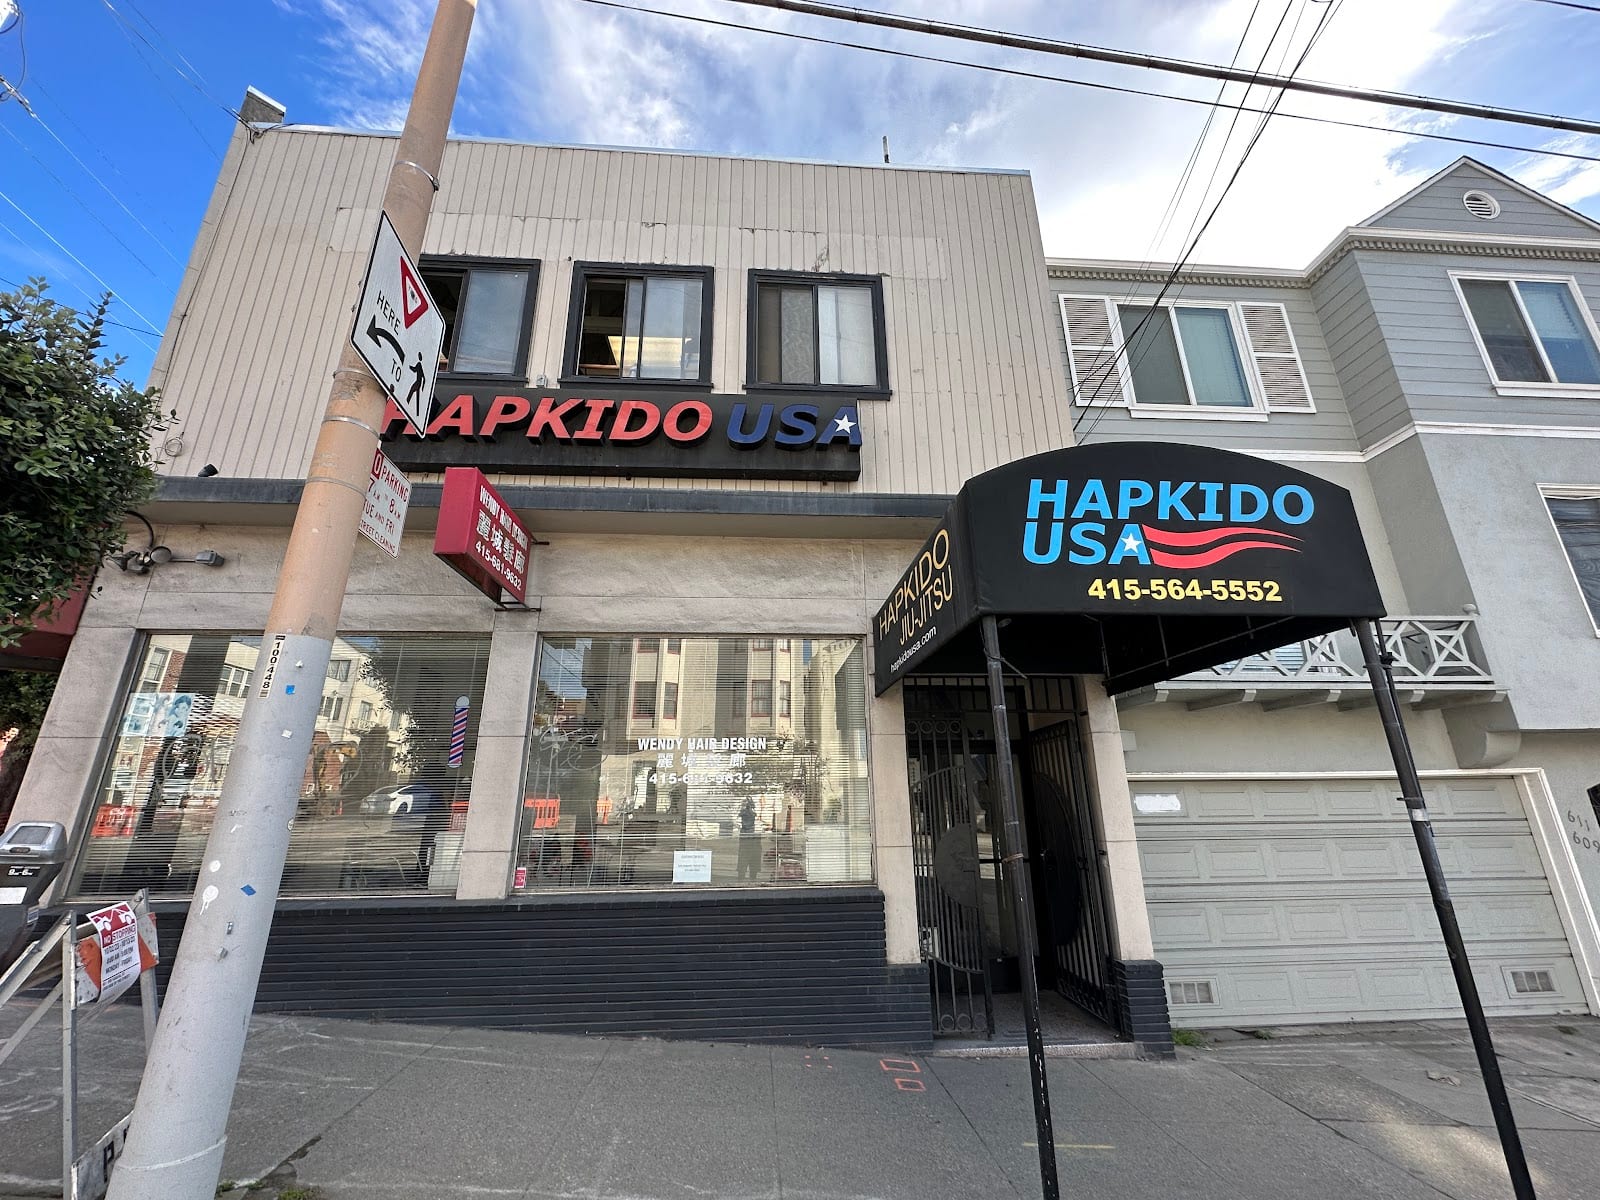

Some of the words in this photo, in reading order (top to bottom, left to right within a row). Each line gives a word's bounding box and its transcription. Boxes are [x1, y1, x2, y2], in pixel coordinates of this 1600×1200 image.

[376, 290, 400, 336] HERE
[392, 358, 402, 382] TO
[728, 404, 862, 447] USA
[368, 477, 375, 492] 7
[389, 498, 395, 513] 8
[381, 466, 408, 502] PARKING
[1026, 478, 1315, 524] HAPKIDO
[385, 519, 394, 536] FRI
[1022, 522, 1151, 564] USA
[476, 540, 522, 590] 415-681-9632
[880, 528, 950, 640] HAPKIDO
[900, 565, 952, 646] JIU-JITSU
[1088, 578, 1282, 602] 415-564-5552
[890, 626, 936, 672] hapkidousa.com
[638, 738, 683, 750] WENDY
[721, 738, 766, 750] DESIGN
[1568, 810, 1590, 832] 611
[1573, 831, 1600, 853] 609
